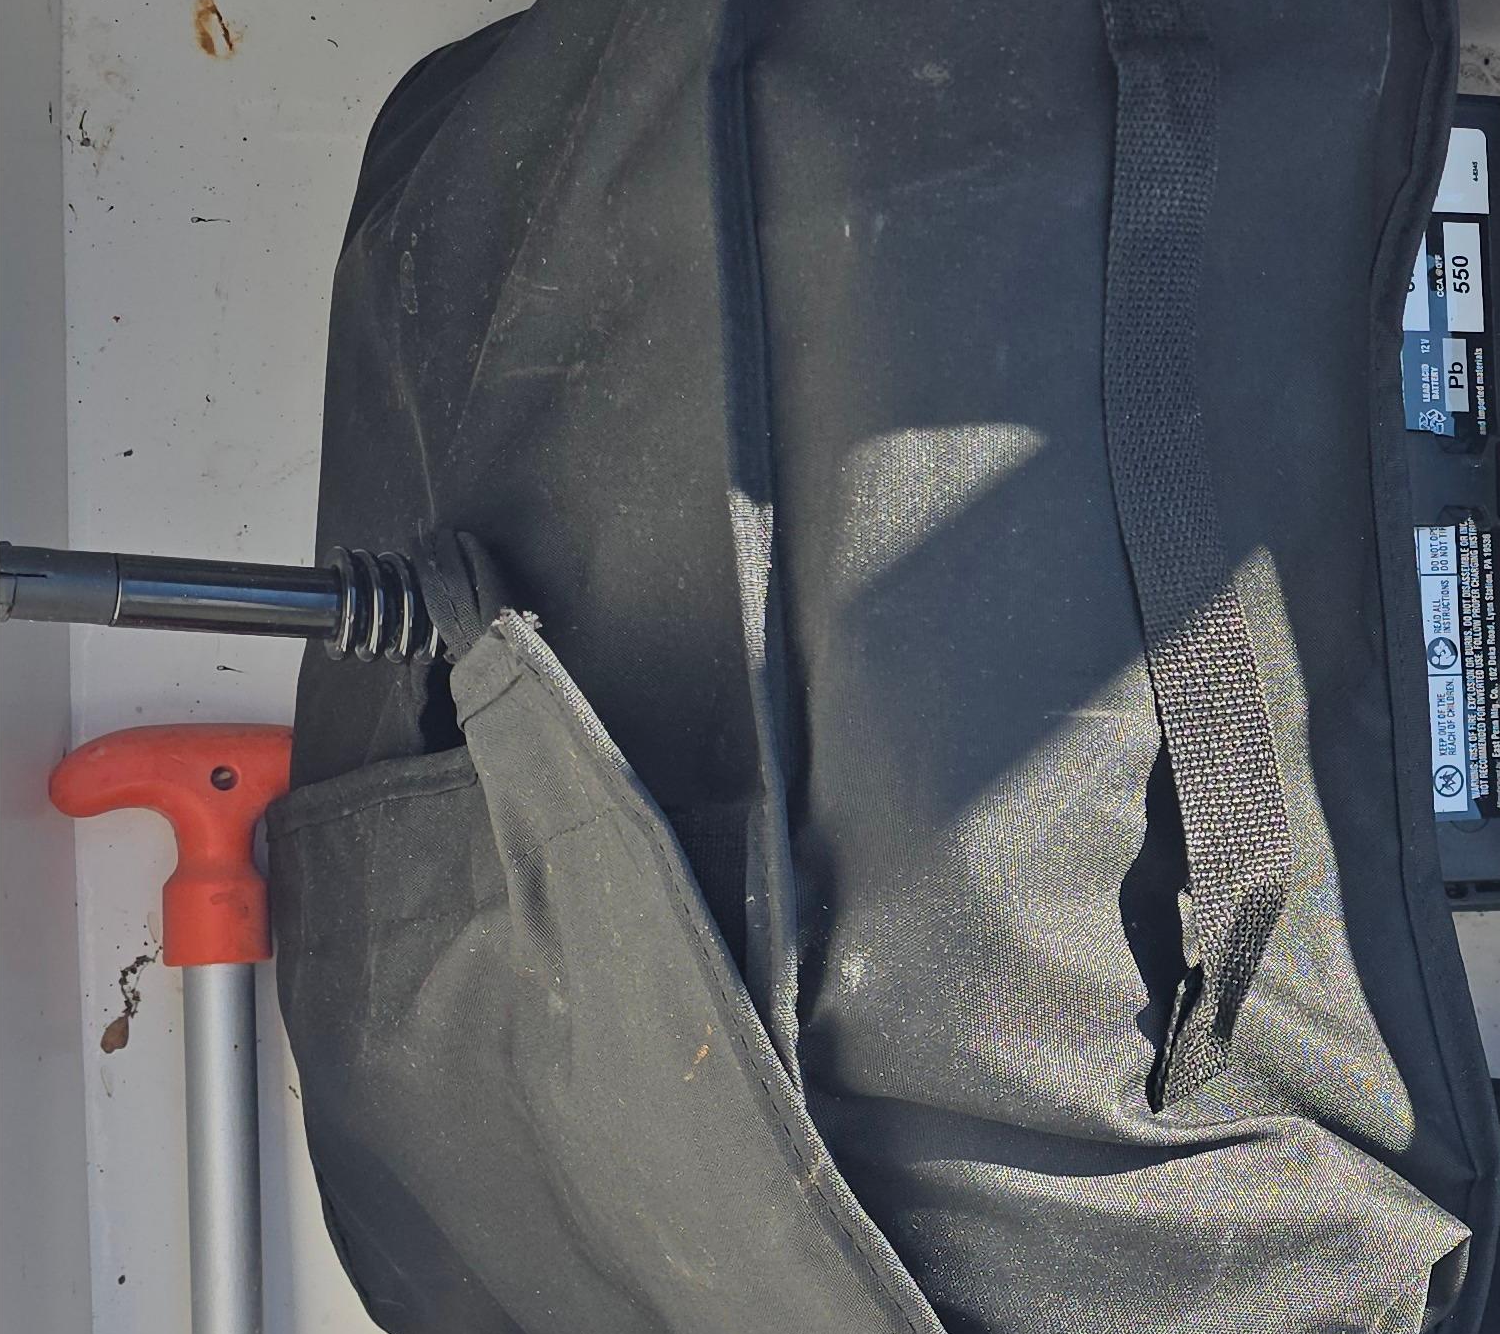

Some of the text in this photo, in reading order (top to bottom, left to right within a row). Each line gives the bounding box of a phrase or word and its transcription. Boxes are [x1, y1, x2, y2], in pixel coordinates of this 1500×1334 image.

[1451, 255, 1470, 294] 550
[1435, 278, 1445, 298] CCA
[1447, 361, 1464, 390] Pb
[1473, 347, 1484, 385] materials
[1421, 363, 1431, 403] LEAD ACID
[1430, 366, 1440, 400] BATTERY
[1475, 385, 1487, 420] imported
[1429, 526, 1440, 572] DO NOT OPE
[1439, 541, 1448, 557] NOT
[1459, 535, 1469, 547] OR
[1440, 560, 1449, 571] DO
[1460, 547, 1471, 598] DISASSEMBLE
[1469, 549, 1480, 588] CHARGING
[1483, 558, 1493, 570] PA
[1462, 599, 1471, 615] NOT
[1471, 588, 1481, 618] PROPER
[1485, 602, 1496, 621] Lyon
[1432, 599, 1442, 634] READ ALL
[1462, 615, 1472, 627] DO
[1472, 619, 1482, 650] FOLLOW
[1465, 656, 1475, 668] OR
[1487, 646, 1497, 666] Deka
[1488, 667, 1498, 681] 102
[1465, 668, 1476, 710] EXPLOSION
[1475, 669, 1485, 705] INVERTED
[1476, 705, 1486, 722] FOR
[1436, 693, 1447, 757] KEEP OUT OF THE
[1446, 720, 1456, 730] OF
[1490, 719, 1500, 740] Penn
[1447, 731, 1457, 756] REACH
[1468, 731, 1478, 742] OF
[1468, 742, 1479, 761] RISK
[1477, 722, 1489, 779] RECOMMENDED
[1491, 740, 1500, 758] East
[1479, 779, 1490, 795] NOT
